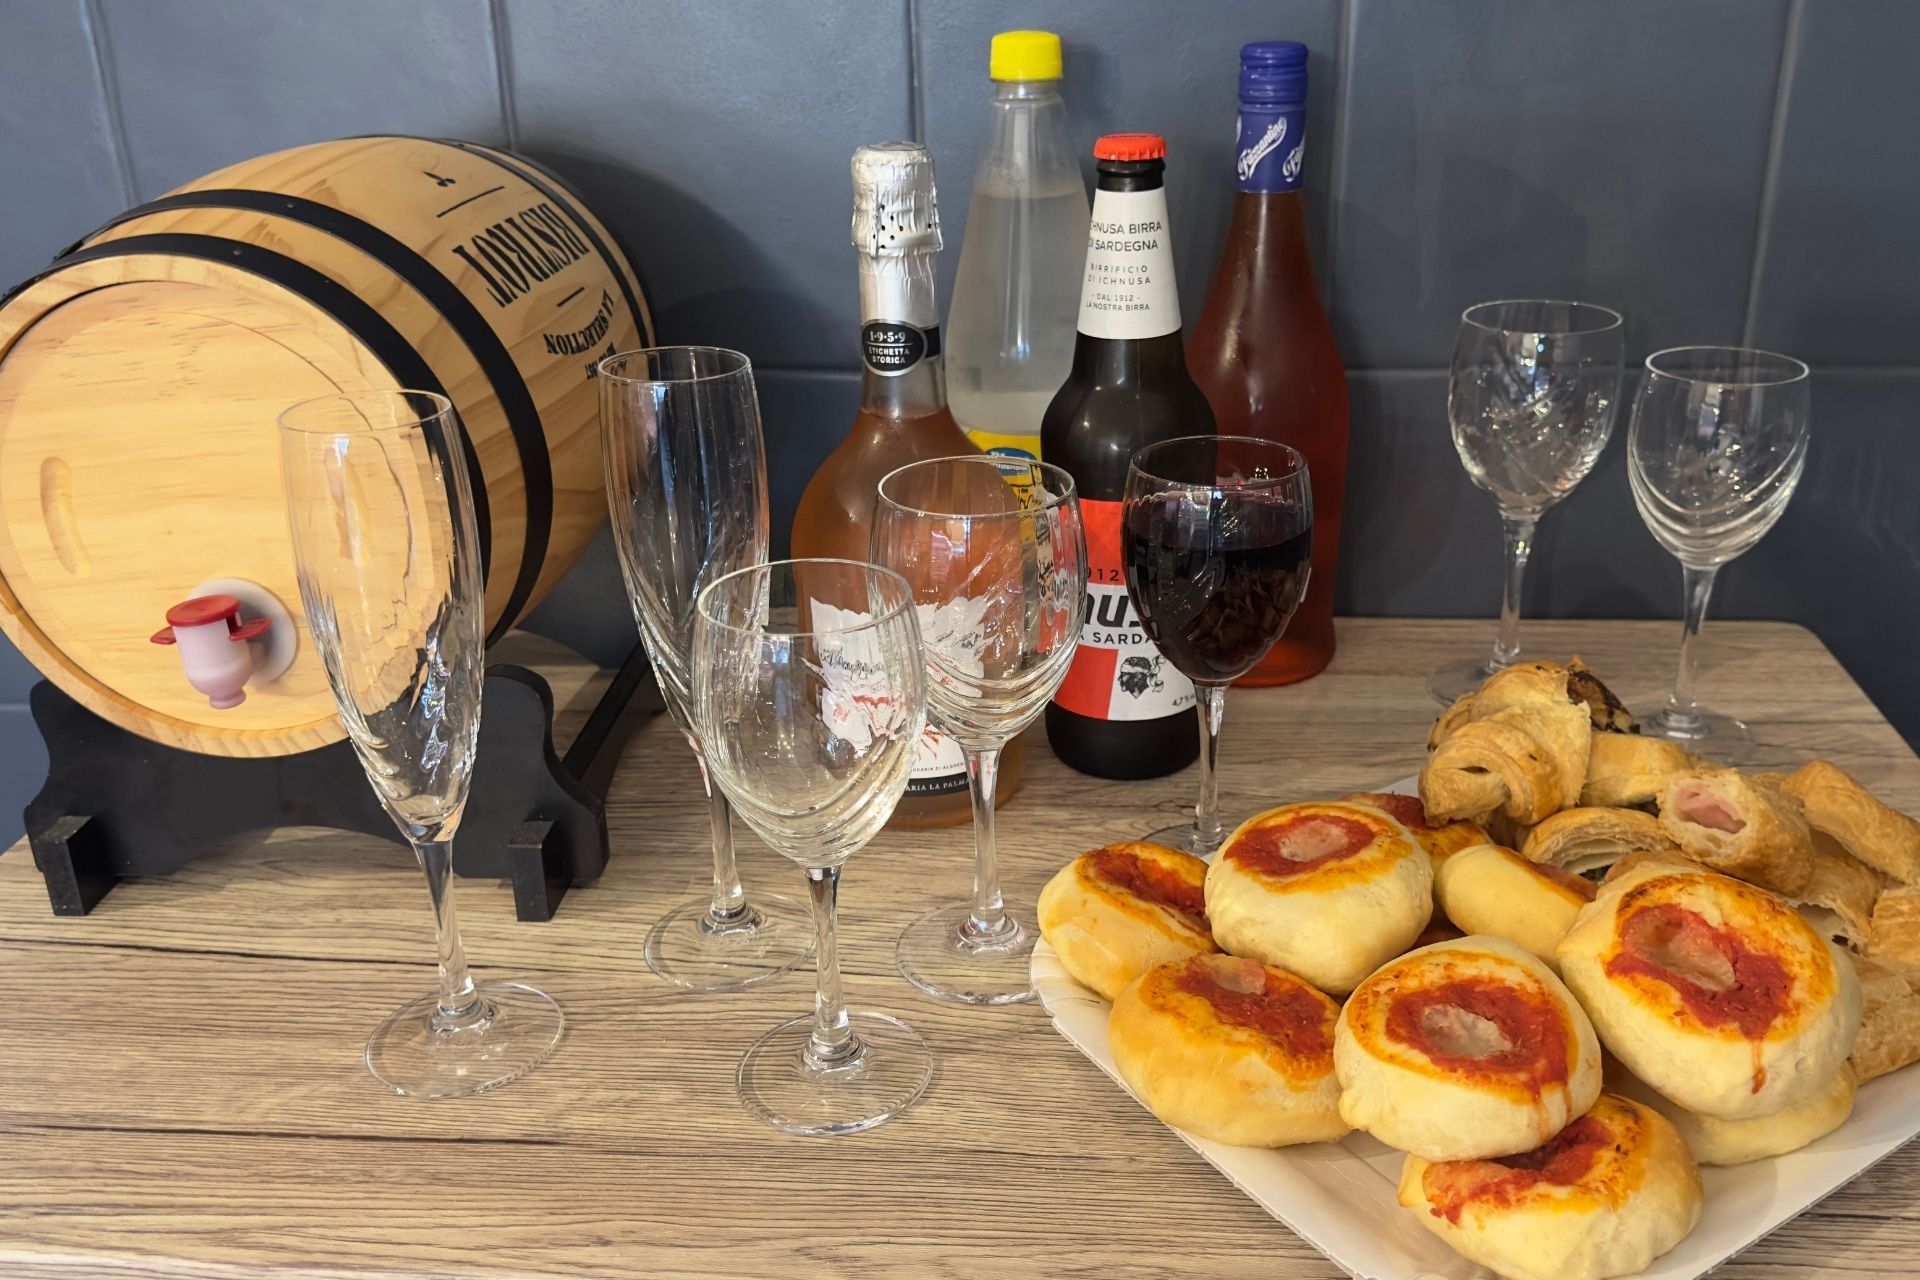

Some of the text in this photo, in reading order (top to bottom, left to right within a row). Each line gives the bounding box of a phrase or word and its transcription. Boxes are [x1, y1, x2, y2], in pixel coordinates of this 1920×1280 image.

[1128, 220, 1162, 234] BIRRA
[1095, 239, 1159, 252] SARDEGNA
[452, 202, 590, 308] BISTROT
[1090, 262, 1148, 273] BIRRIFICIO
[1088, 274, 1151, 285] DI ICHNUSA
[1096, 292, 1135, 302] DAL 1912
[1093, 302, 1123, 311] NOSTRA
[1125, 303, 1150, 311] BIRRA
[543, 308, 609, 355] SELECTION
[868, 346, 910, 356] ETICHETTA
[872, 355, 906, 364] STORICA
[929, 783, 941, 791] LA
